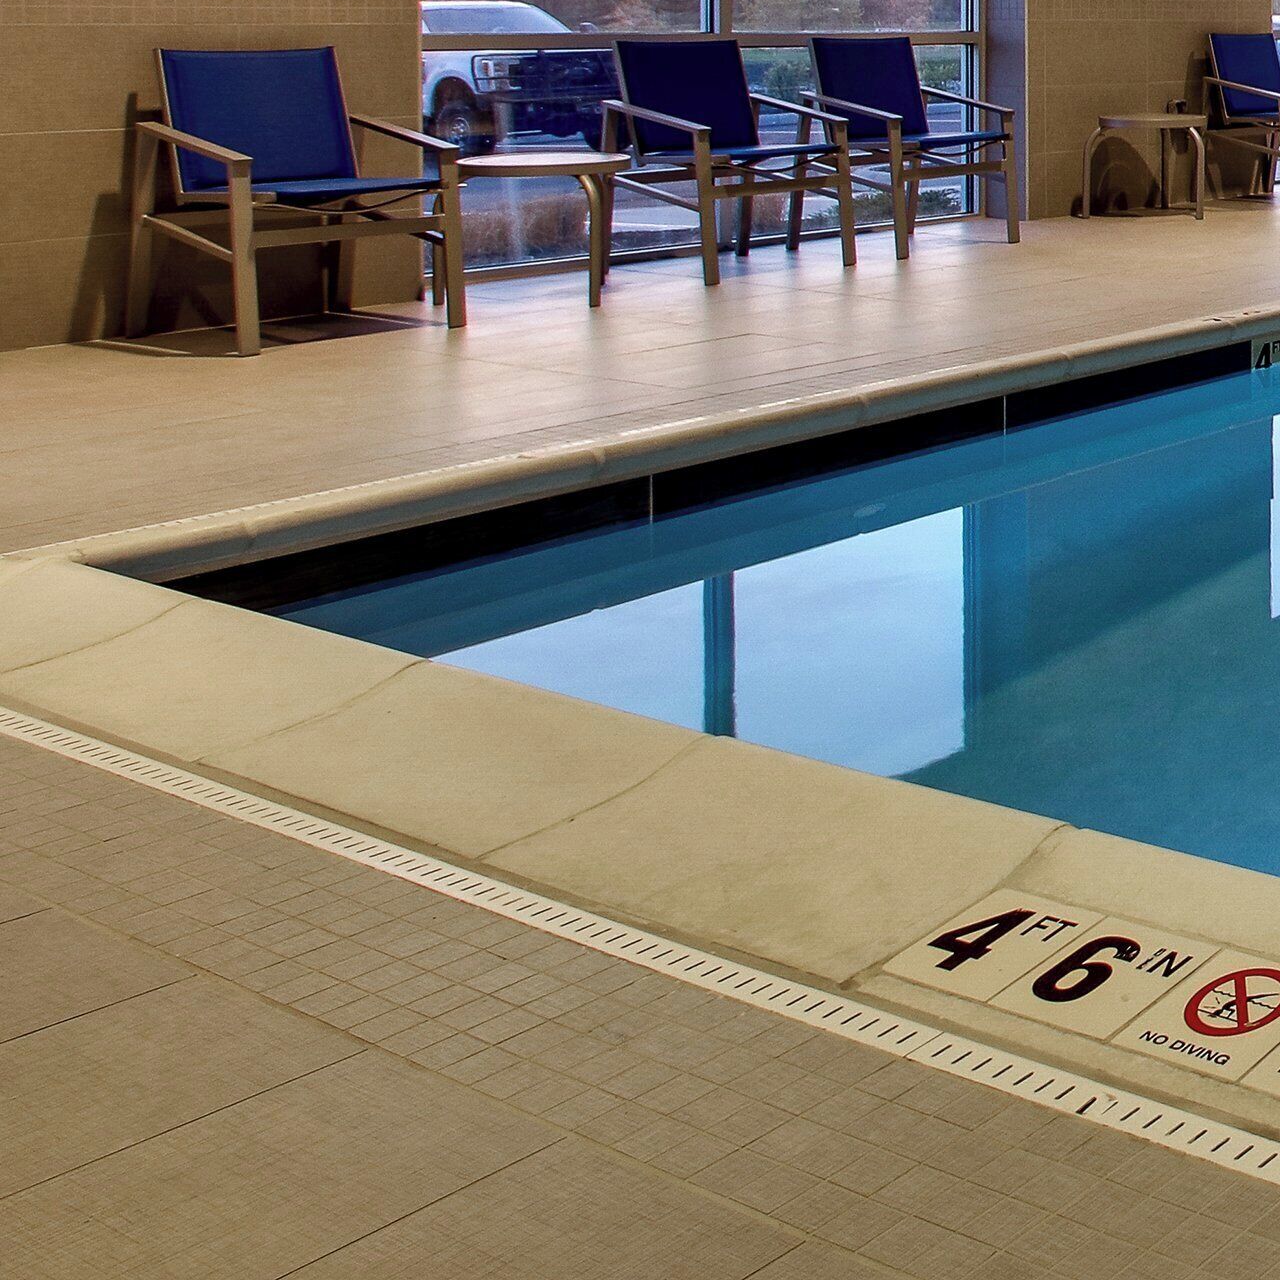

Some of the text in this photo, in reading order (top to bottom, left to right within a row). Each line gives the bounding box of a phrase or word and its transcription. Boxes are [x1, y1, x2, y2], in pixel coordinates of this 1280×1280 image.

[1255, 342, 1273, 369] 4
[926, 908, 1037, 972] 4
[1031, 936, 1140, 1003] 6
[1139, 1030, 1231, 1066] NO DIVING
